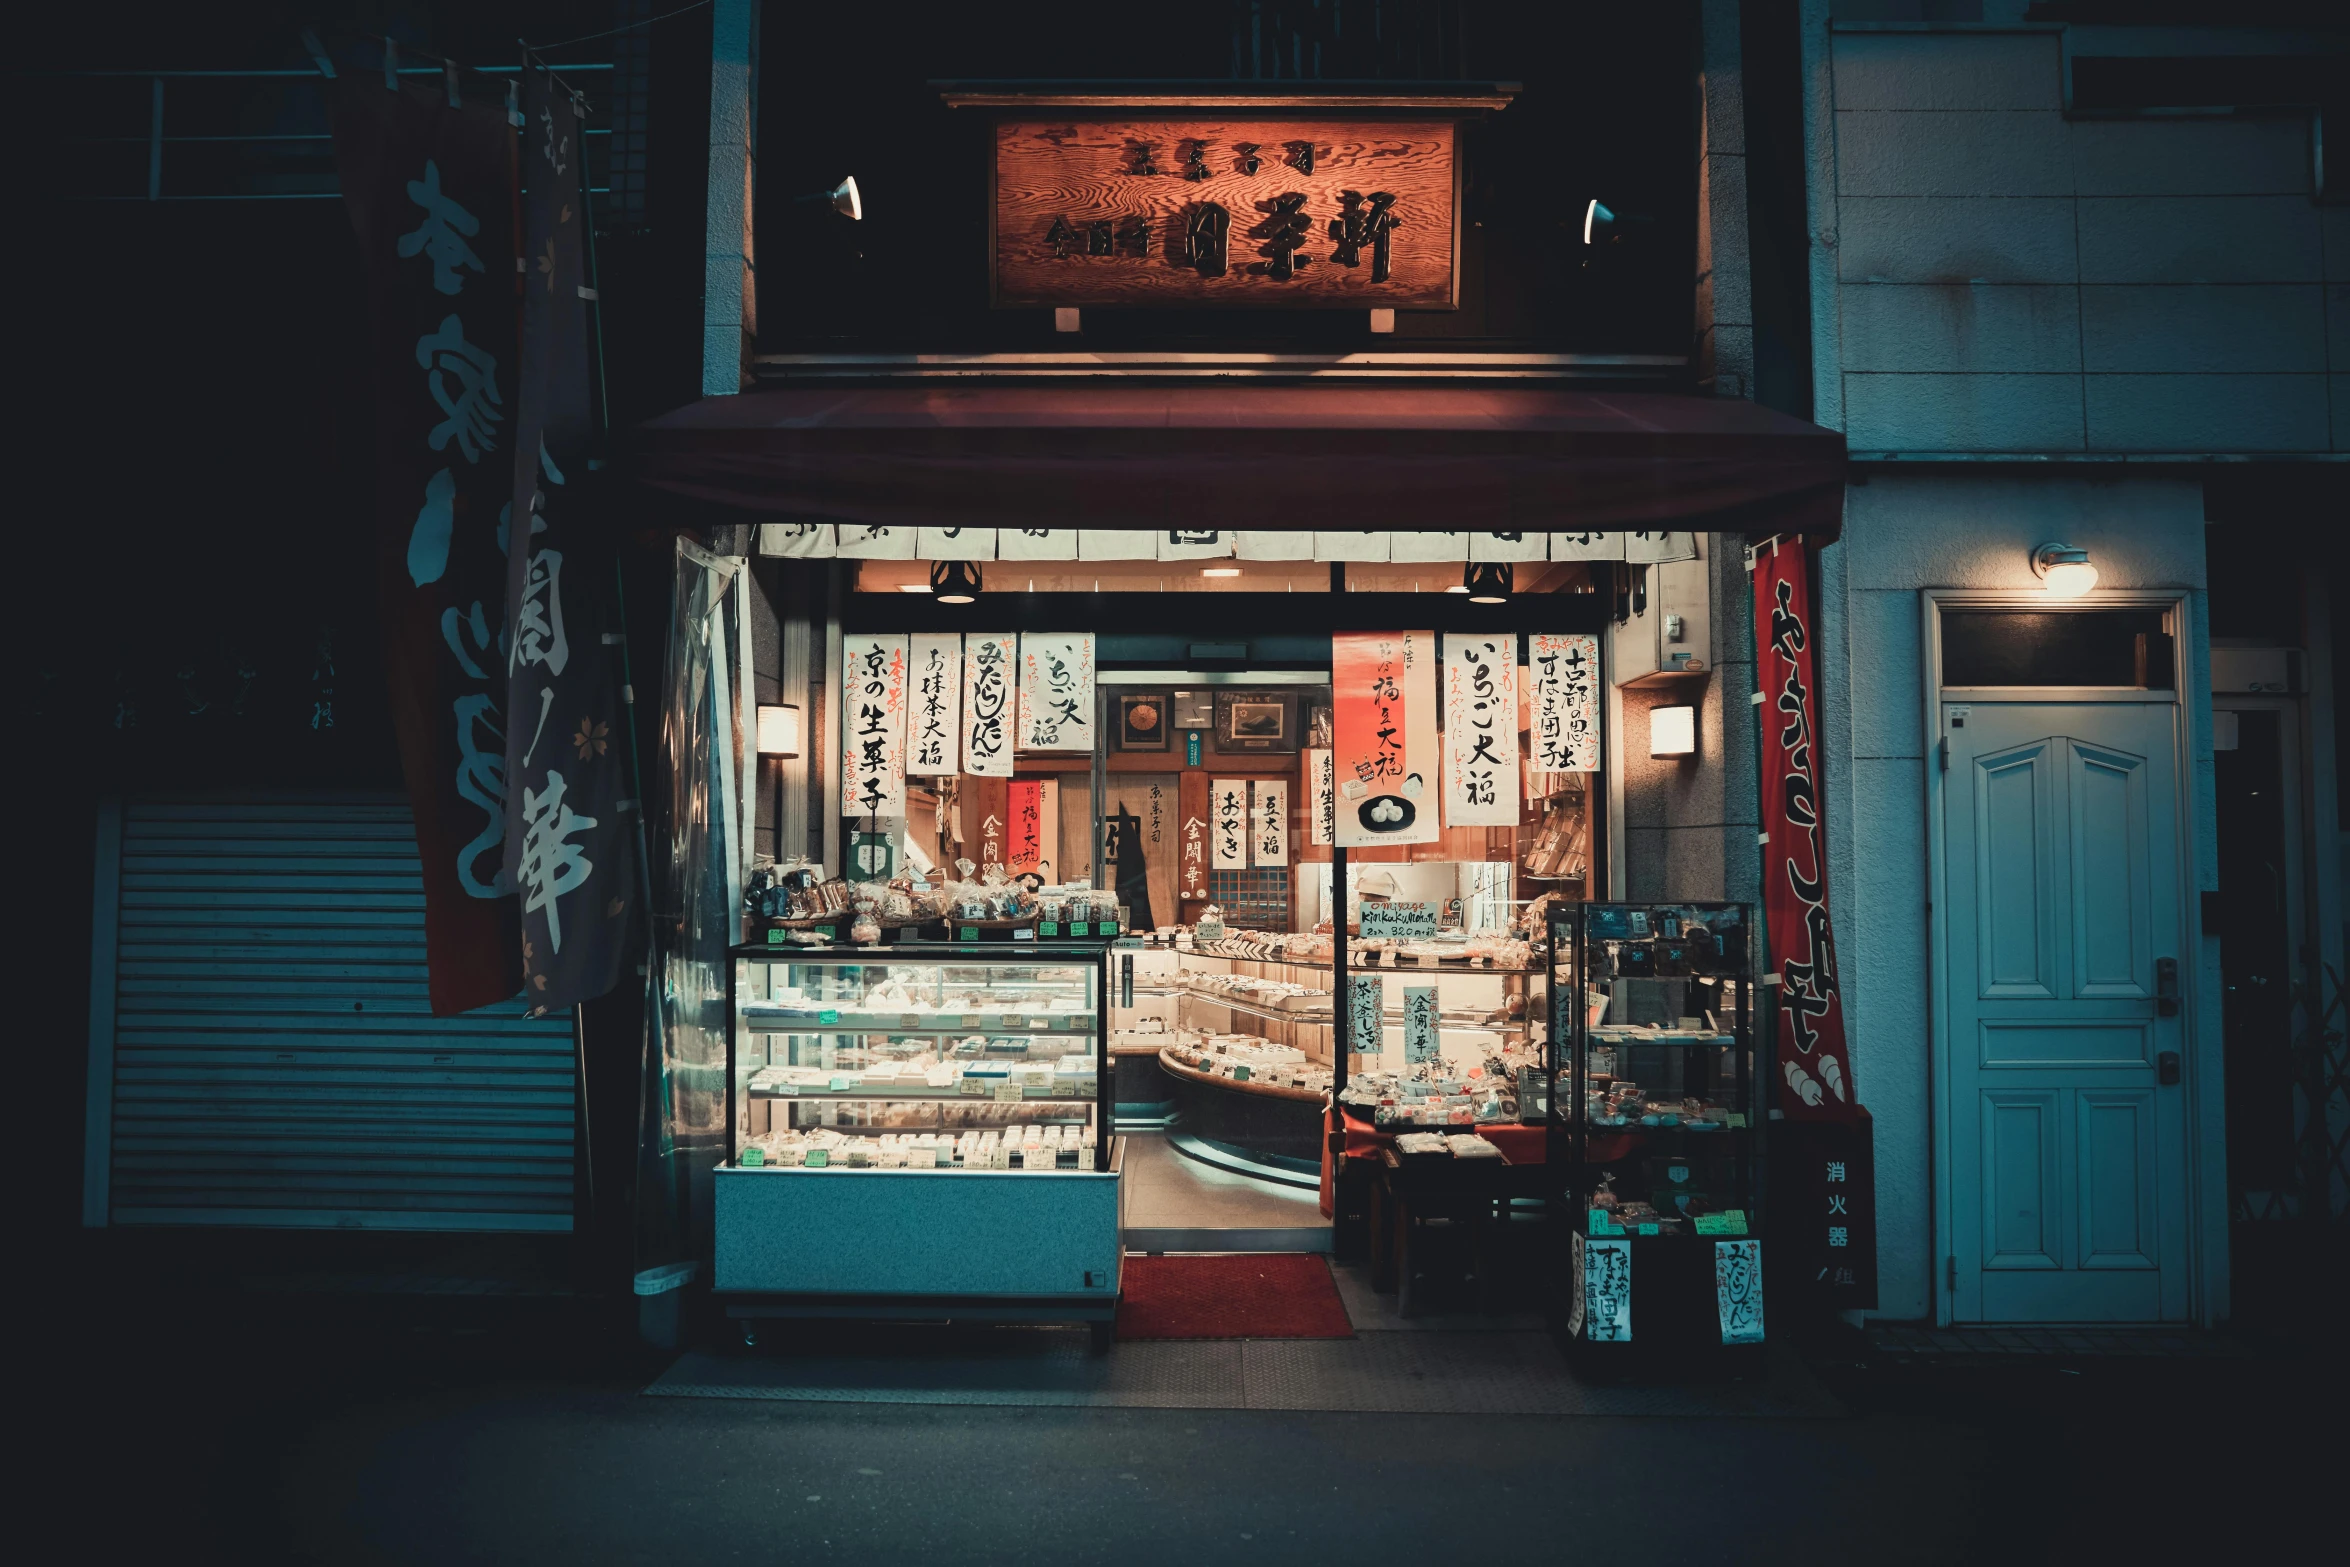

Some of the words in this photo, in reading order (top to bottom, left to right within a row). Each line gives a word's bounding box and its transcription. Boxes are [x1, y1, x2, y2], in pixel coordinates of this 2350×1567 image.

[858, 642, 888, 811] 京の生菓子
[918, 648, 947, 766] お抹茶大福
[972, 641, 1006, 772] みたらしだんご
[1031, 645, 1087, 746] いちご大福
[1464, 642, 1503, 806] いちご大福
[1537, 650, 1561, 768] すはま団子
[1221, 791, 1240, 859] おやき
[1263, 795, 1280, 855] 豆大福
[1826, 1161, 1848, 1248] 消火器
[1596, 1244, 1623, 1340] すはま団子
